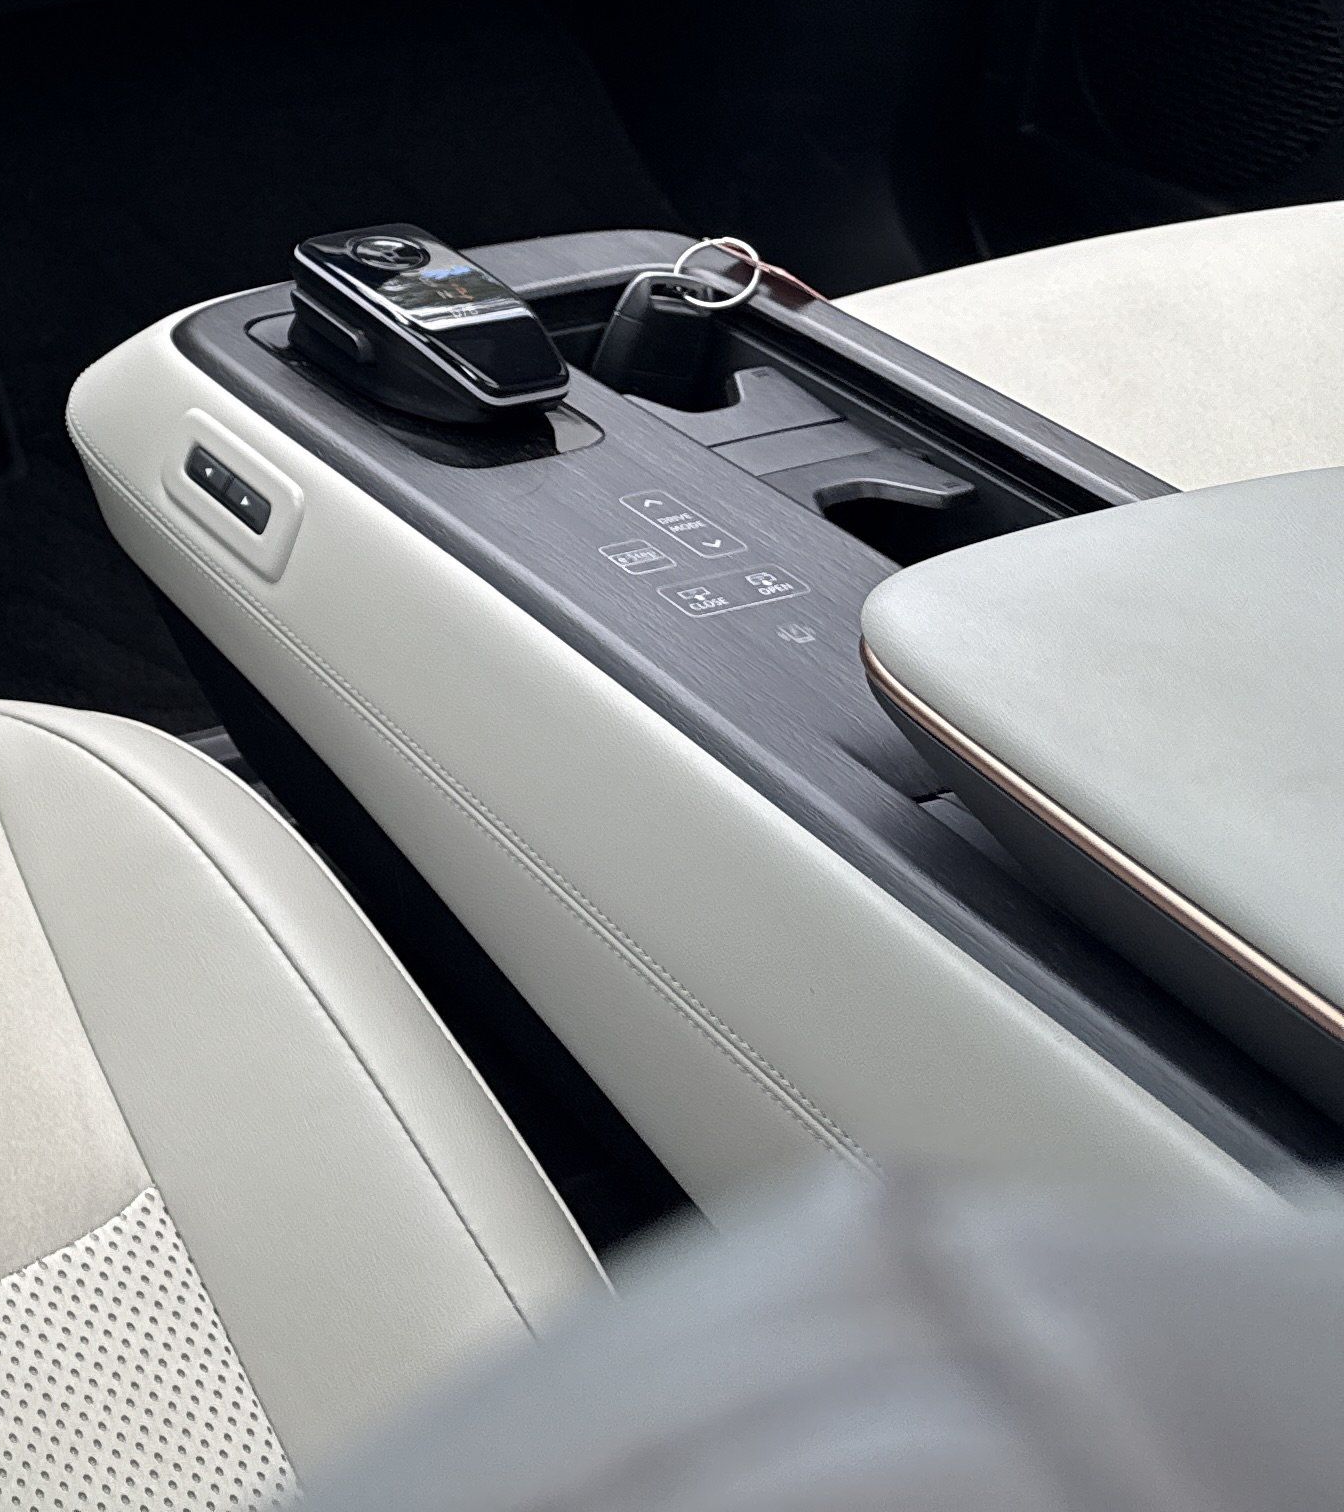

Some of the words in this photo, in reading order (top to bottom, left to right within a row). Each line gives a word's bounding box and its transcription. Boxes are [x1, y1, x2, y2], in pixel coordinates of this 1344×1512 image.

[657, 512, 694, 526] DRIVE
[668, 520, 707, 534] MODE
[757, 582, 795, 597] OPEN
[688, 596, 730, 611] CLOSE
